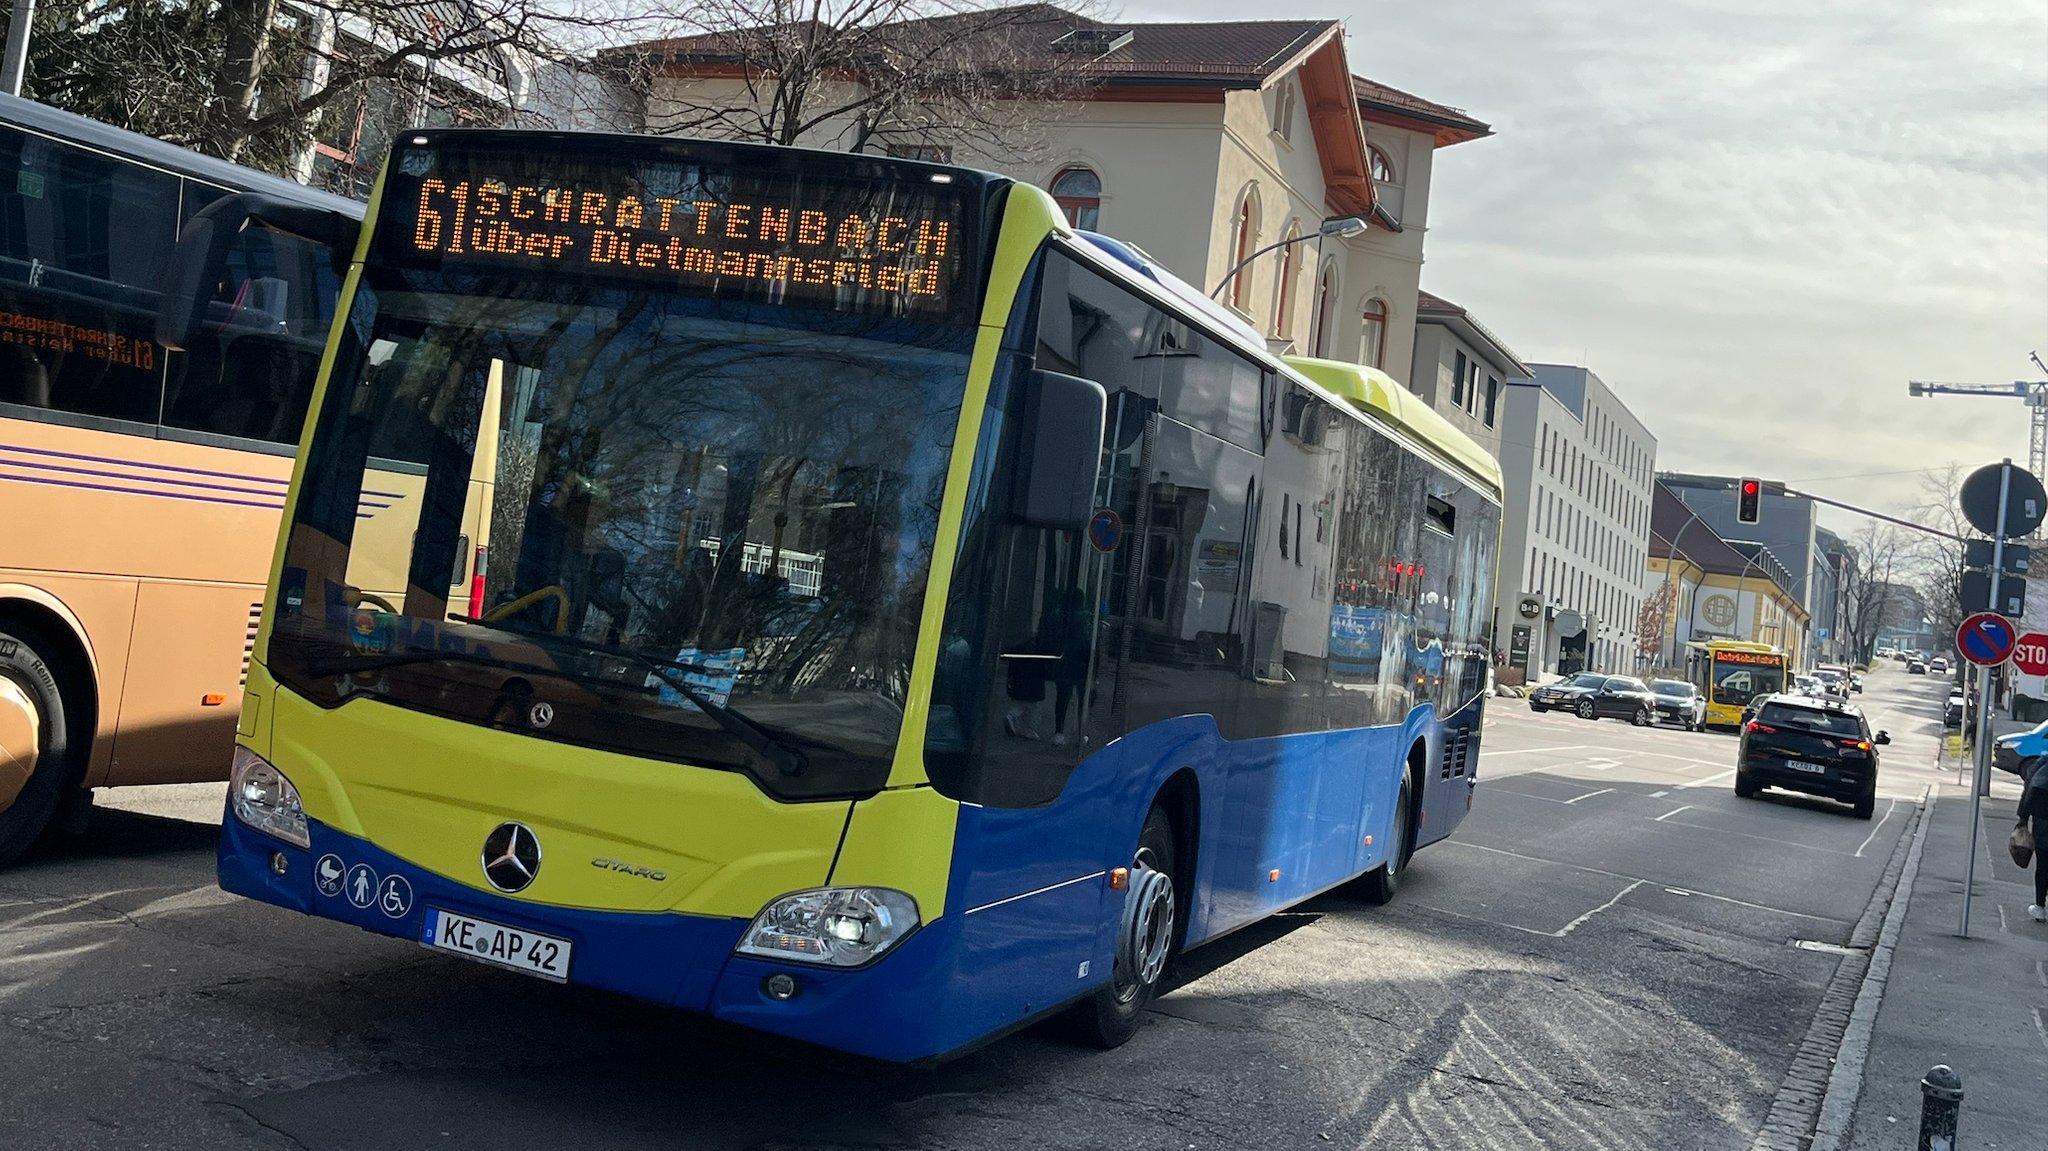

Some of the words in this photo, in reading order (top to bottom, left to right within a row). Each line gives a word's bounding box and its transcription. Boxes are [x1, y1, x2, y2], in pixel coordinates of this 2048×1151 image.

[415, 178, 469, 254] 61
[476, 182, 949, 257] SCHRATTENBACH
[471, 218, 574, 259] über
[590, 228, 940, 295] Dietmannsried
[31, 659, 57, 697] Remix
[2015, 643, 2048, 665] STO
[591, 856, 667, 881] CITARO
[426, 929, 433, 938] D
[444, 917, 476, 950] KE
[490, 930, 523, 960] AP
[527, 939, 559, 971] 42
